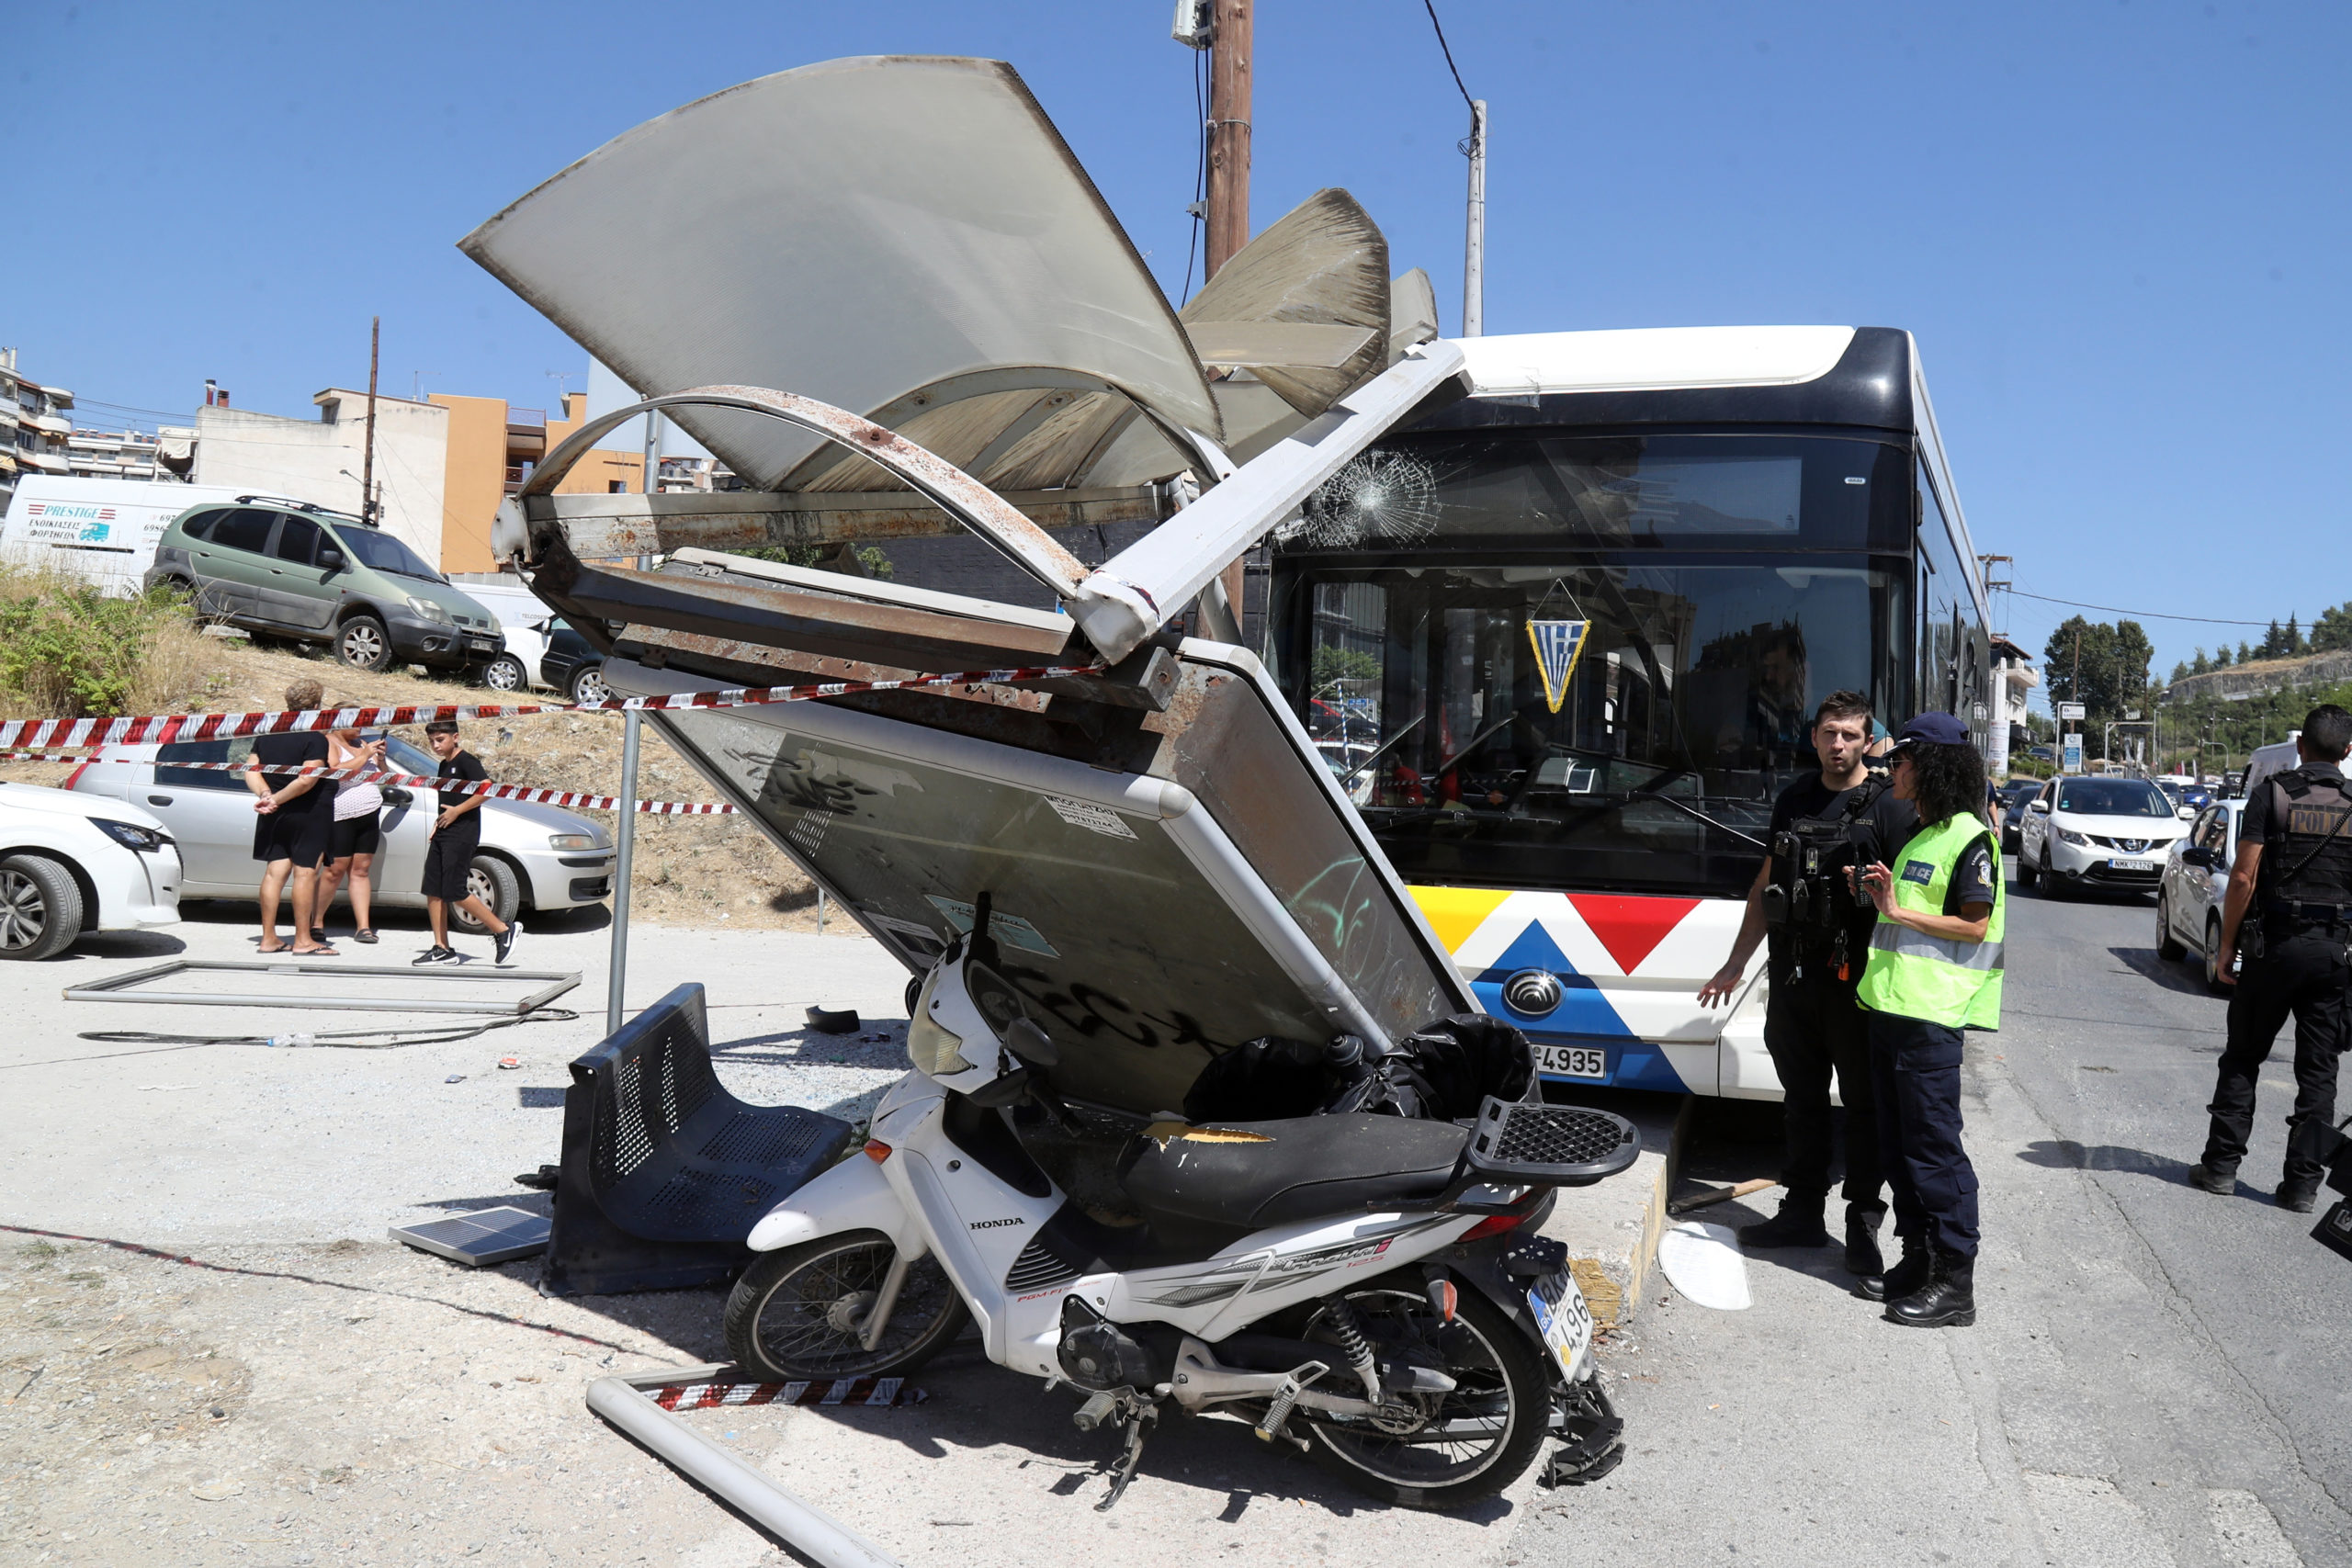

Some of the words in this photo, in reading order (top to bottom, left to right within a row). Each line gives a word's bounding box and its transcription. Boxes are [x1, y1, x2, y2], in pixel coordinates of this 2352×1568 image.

[43, 505, 100, 519] PRESTIGE
[28, 518, 81, 530] ΕΝΟΙΚΙΑΣΕΙΣ
[29, 529, 75, 540] ΦΟΡΤΗΓΩΝ
[1905, 865, 1932, 881] POLCE
[970, 1217, 1025, 1230] HONDA
[1347, 1254, 1386, 1268] 125
[1561, 1293, 1589, 1352] 496
